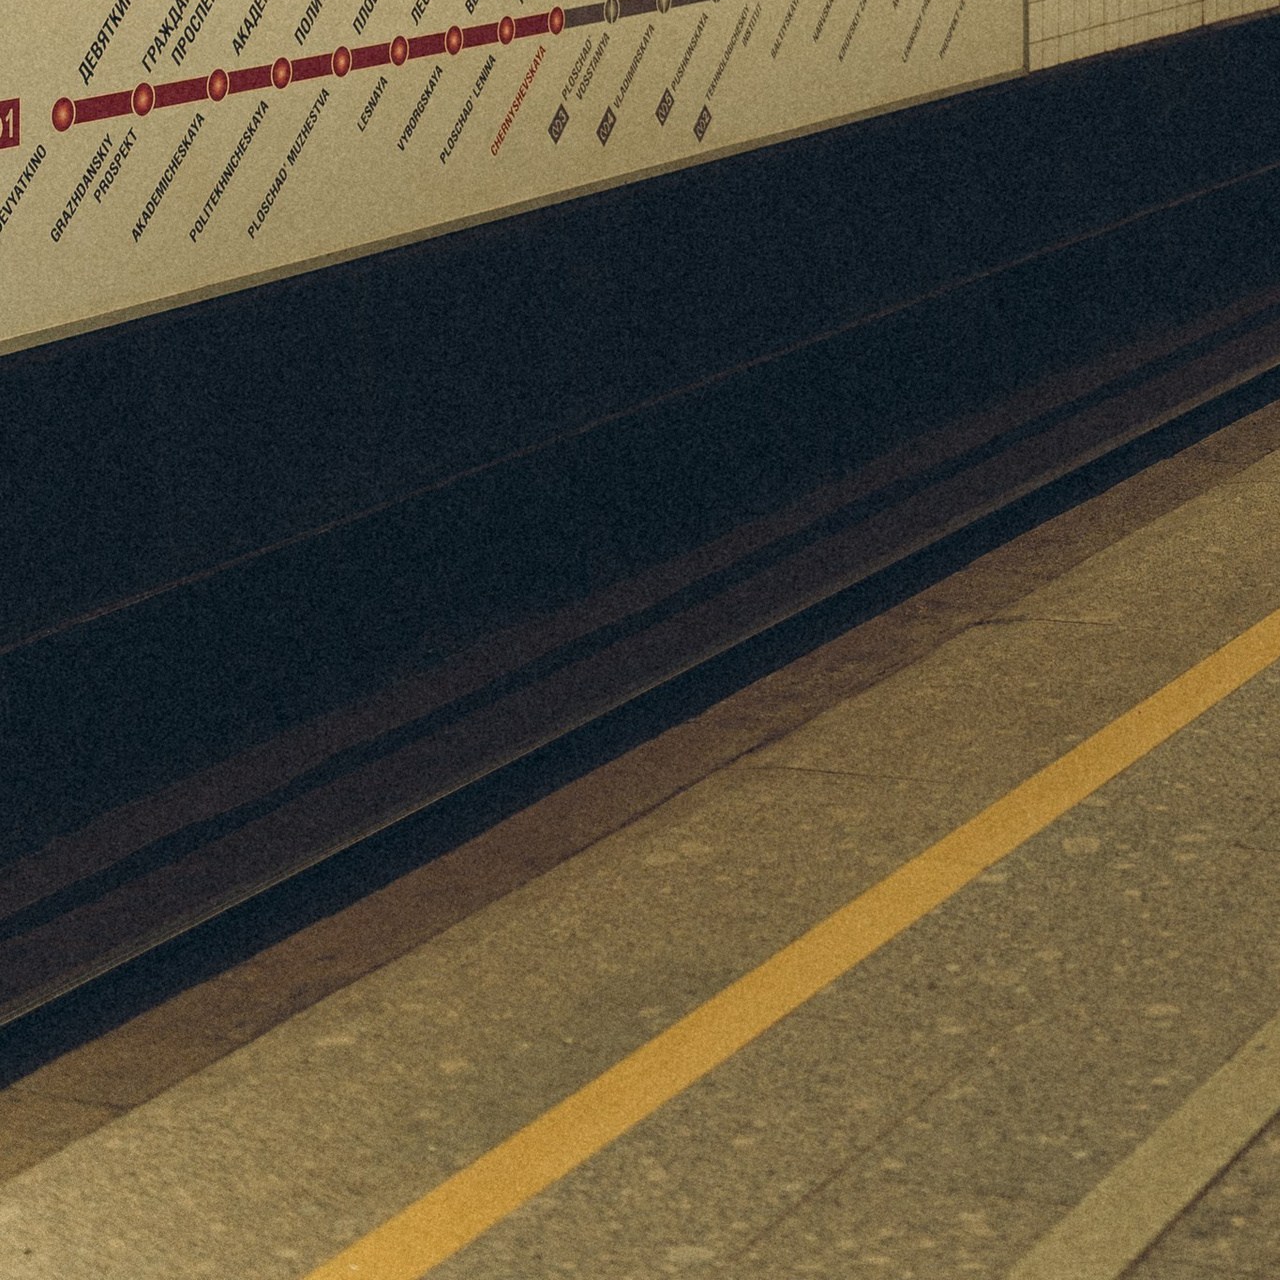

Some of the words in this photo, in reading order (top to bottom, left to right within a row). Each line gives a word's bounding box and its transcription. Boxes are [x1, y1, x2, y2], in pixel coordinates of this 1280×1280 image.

[472, 54, 496, 99] LENINA
[575, 32, 610, 101] VOSSTANIYA
[613, 23, 655, 110] VLADIMIRSKAYA
[670, 12, 709, 92] PUSHKINSKAYA
[286, 87, 331, 167] MUZHESTVA
[356, 76, 388, 133] LESNAYA
[397, 65, 444, 152] VYBORGSKAYA
[490, 45, 547, 157] CHERNYSHEVSKAYA
[50, 133, 114, 243] GRAZHDANSKIY
[93, 126, 138, 204] PROSPEKT
[131, 112, 205, 243] AKADEMICHESKAYA
[189, 100, 270, 243] POLITEKHNICHESKAYA
